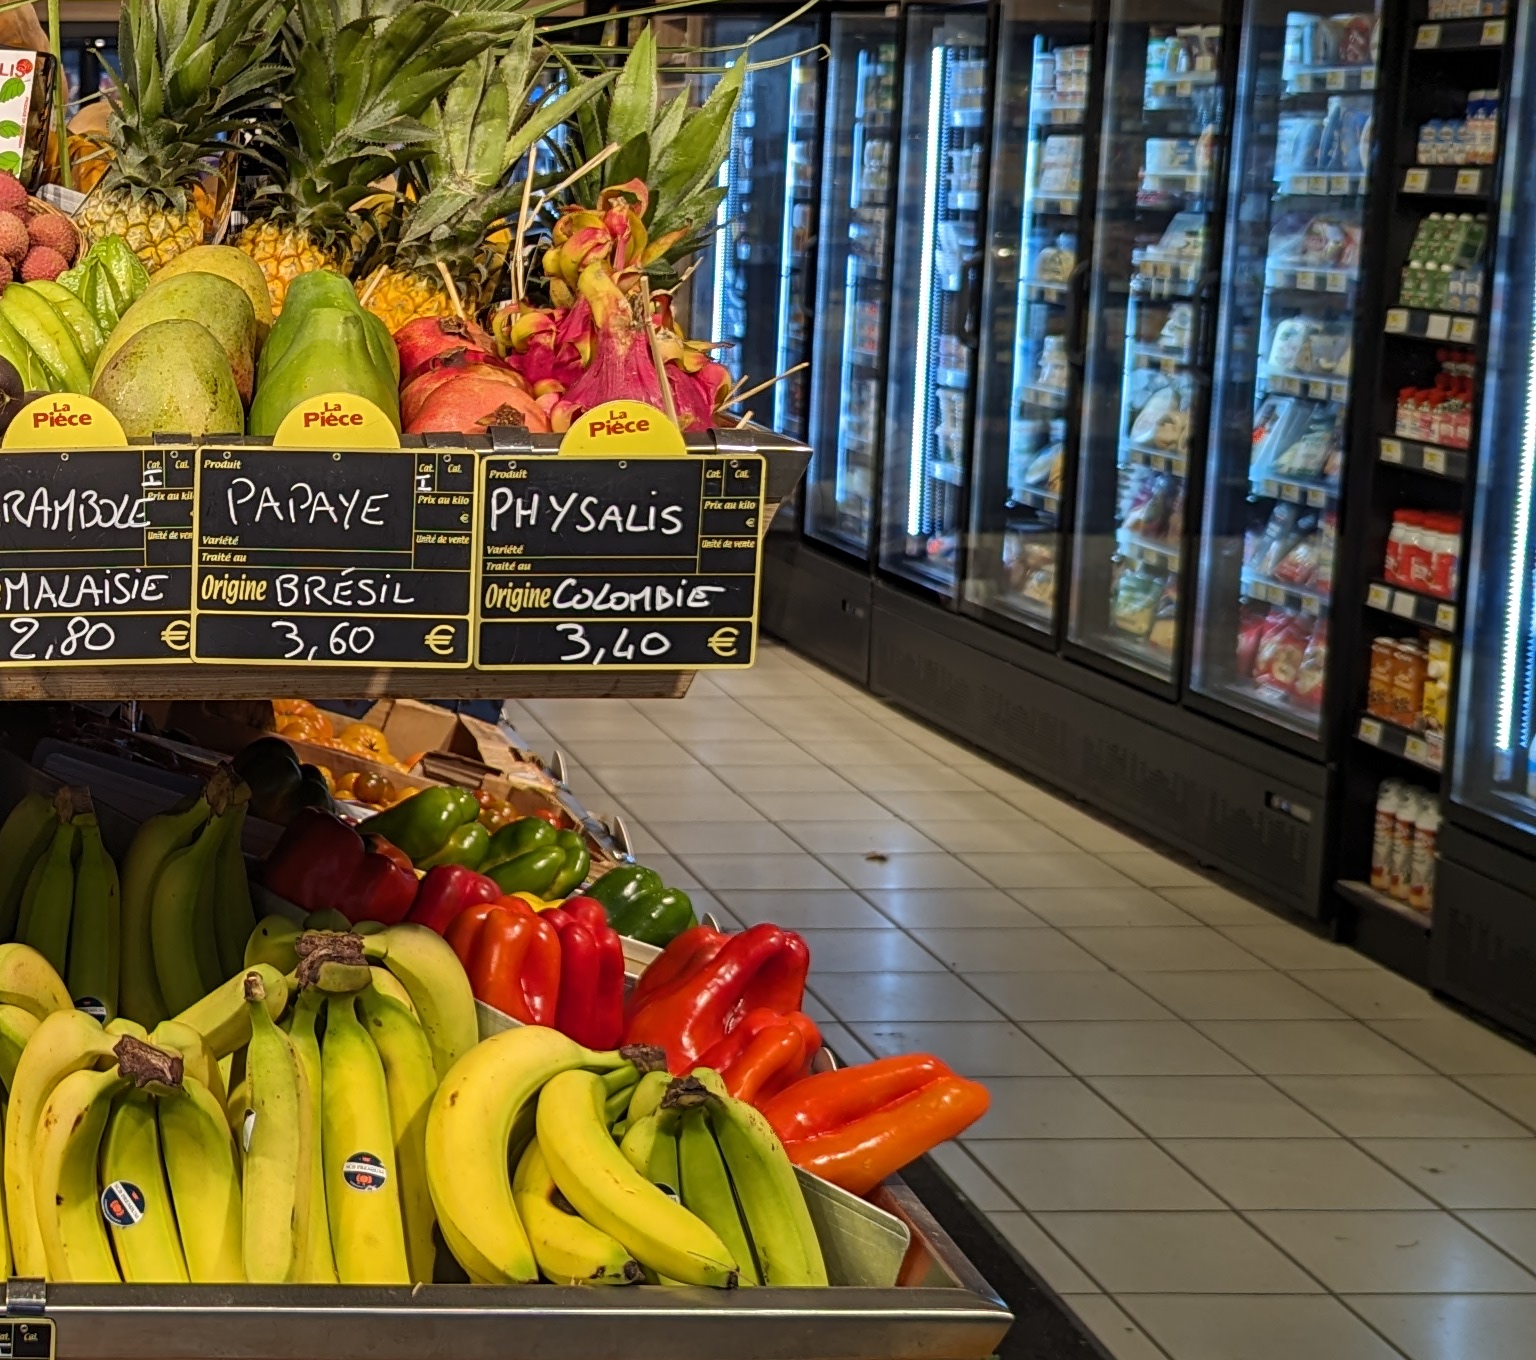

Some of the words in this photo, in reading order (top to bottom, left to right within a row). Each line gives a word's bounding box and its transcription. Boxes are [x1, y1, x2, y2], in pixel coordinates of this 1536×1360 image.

[53, 402, 71, 412] La
[324, 401, 342, 412] La
[33, 411, 93, 429] Pièce
[303, 411, 364, 428] Pièce
[609, 410, 627, 421] La
[589, 419, 650, 438] Pièce
[204, 459, 242, 470] Produit
[489, 469, 528, 479] Produit
[227, 477, 390, 531] PAPAYE
[418, 495, 436, 505] Prix
[437, 496, 450, 505] au
[452, 495, 470, 505] kilo
[704, 500, 723, 510] Prix
[724, 501, 737, 510] au
[738, 500, 756, 510] kilo
[490, 487, 683, 535] PHYSALIS
[202, 535, 239, 546] Variété
[487, 545, 525, 555] Variété
[201, 552, 232, 563] Traité
[233, 553, 247, 563] au
[486, 561, 516, 571] Traité
[517, 562, 532, 571] au
[4, 567, 169, 611] MALAISIE
[201, 573, 267, 605] Origine
[485, 582, 552, 612] Origine
[10, 616, 116, 661] 2,80
[160, 619, 191, 651] €
[271, 620, 375, 662] 3,60
[424, 624, 456, 655] €
[556, 623, 672, 666] 3,40
[707, 626, 740, 657] €
